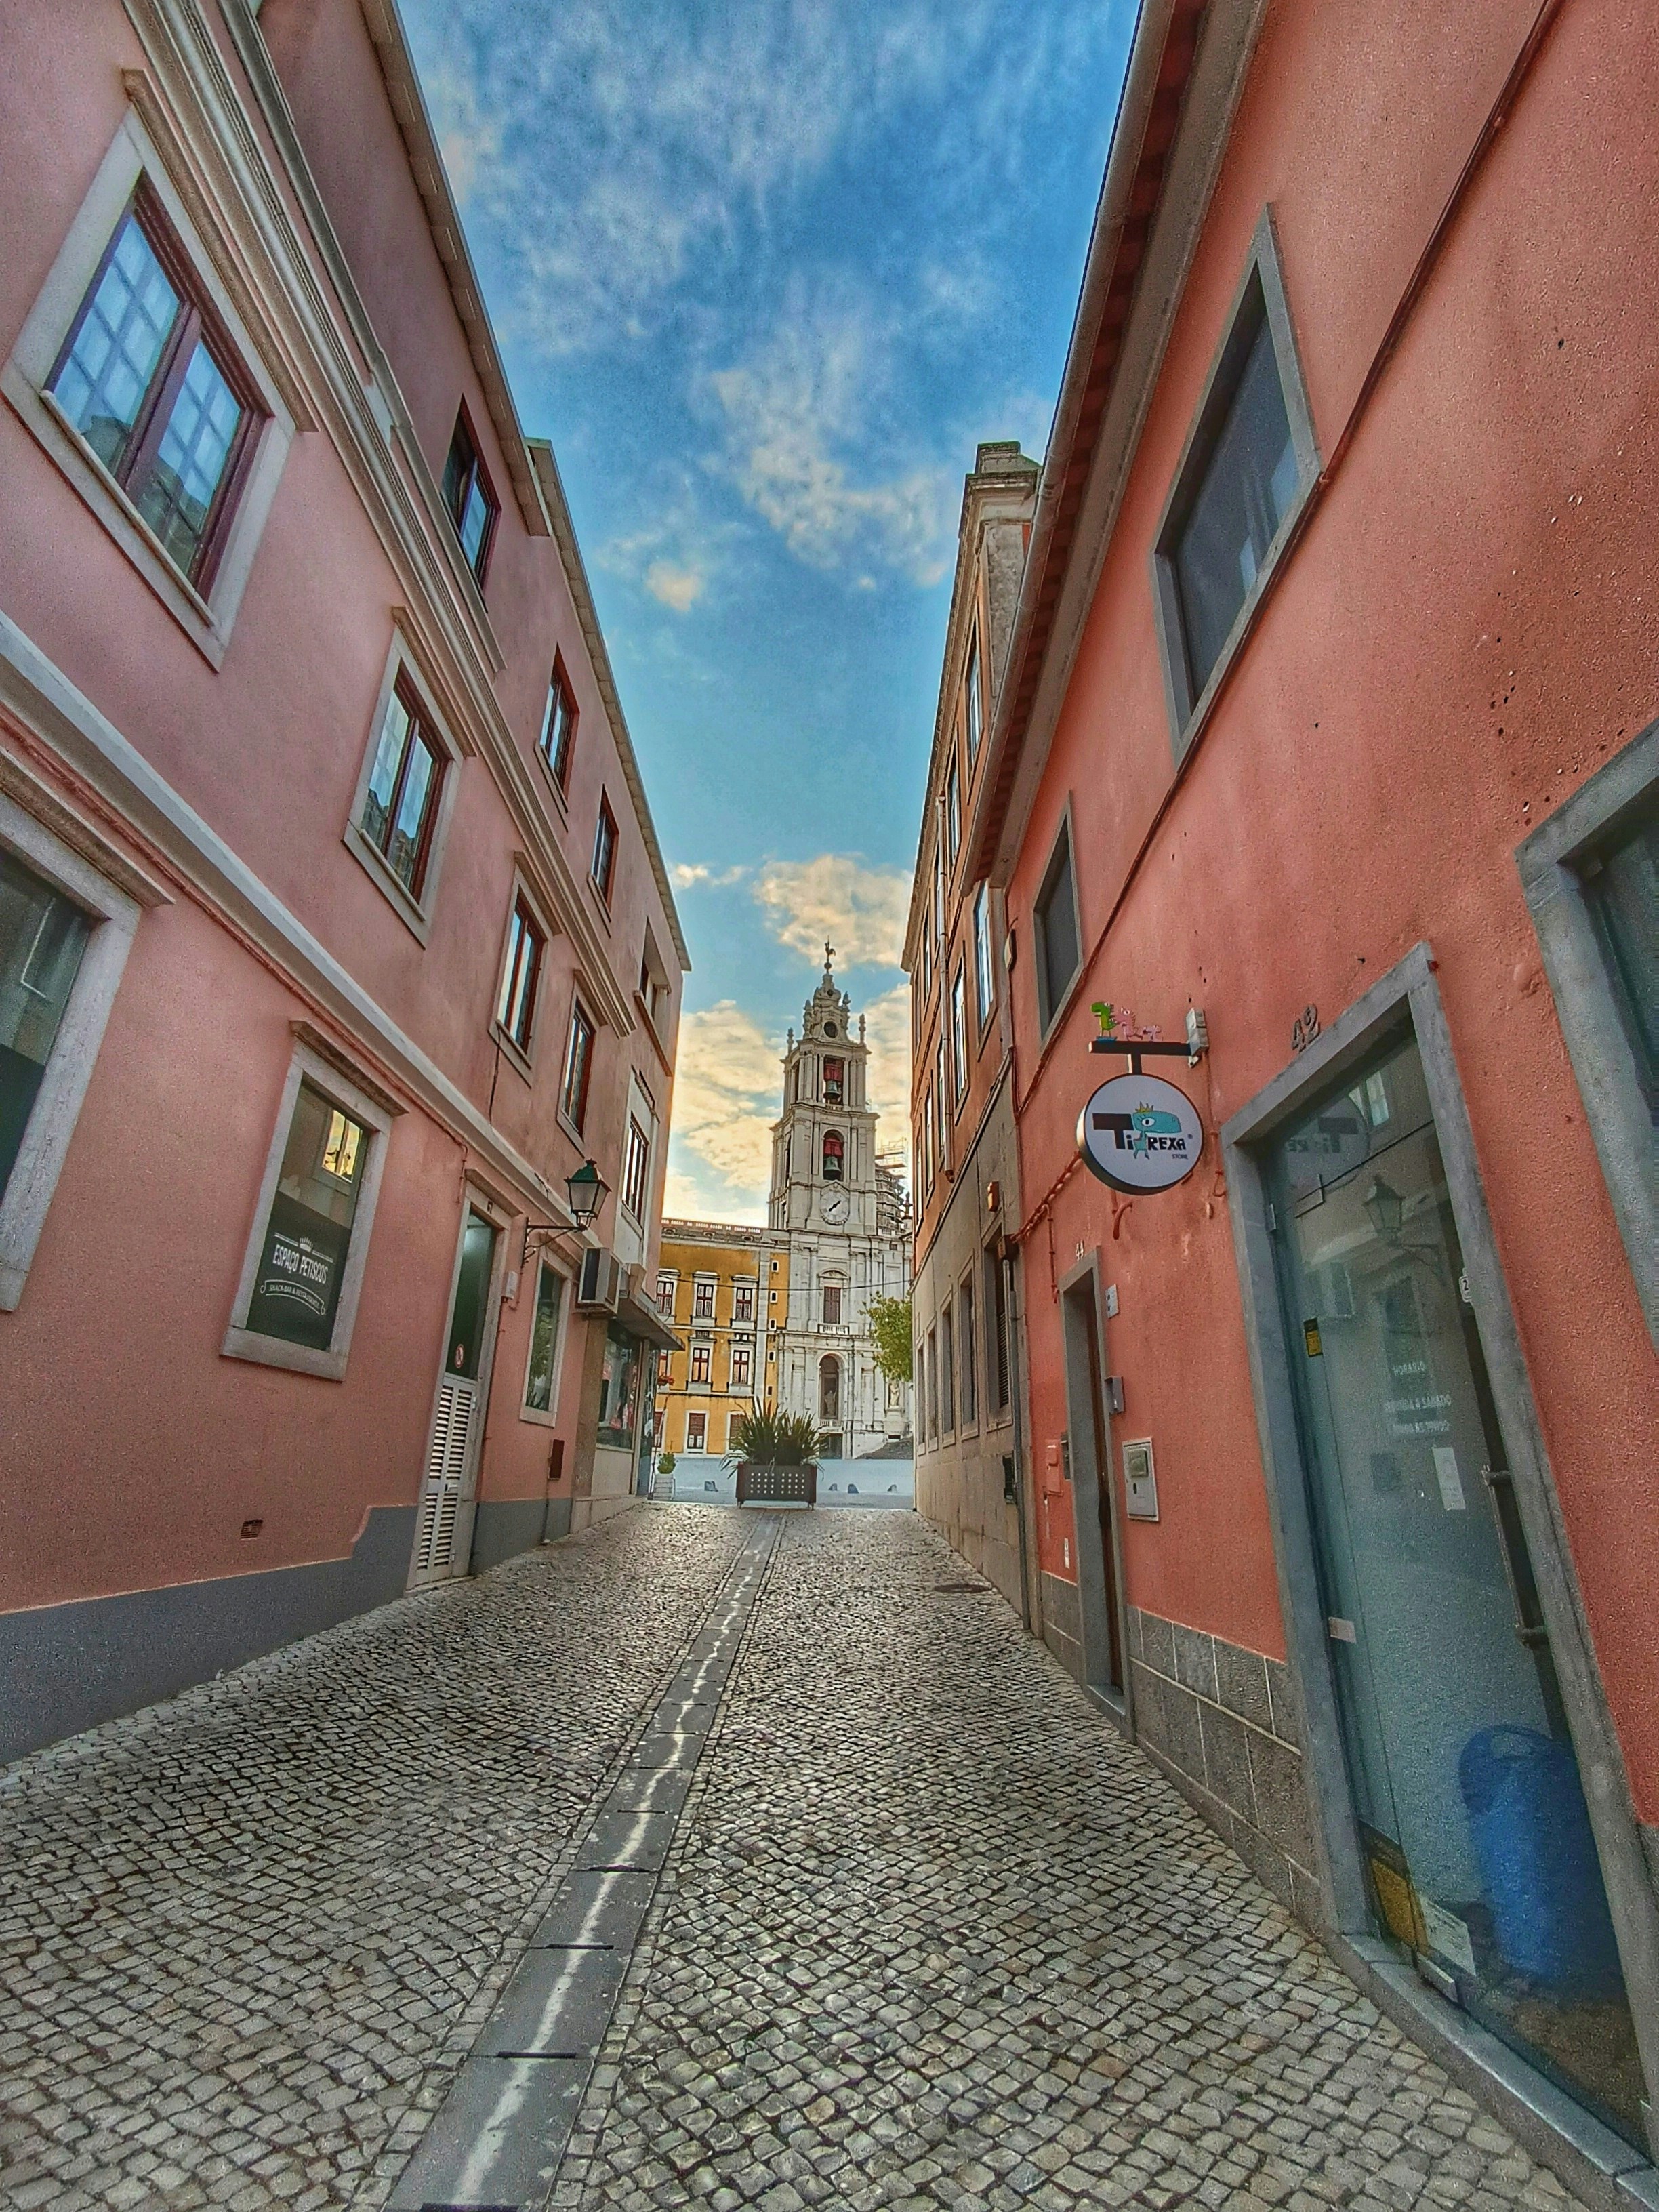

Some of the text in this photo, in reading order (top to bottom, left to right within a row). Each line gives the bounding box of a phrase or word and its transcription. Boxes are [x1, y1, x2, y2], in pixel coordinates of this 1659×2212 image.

[1290, 1003, 1320, 1053] 42
[272, 1244, 328, 1284] ESPAÇO PETISCOS
